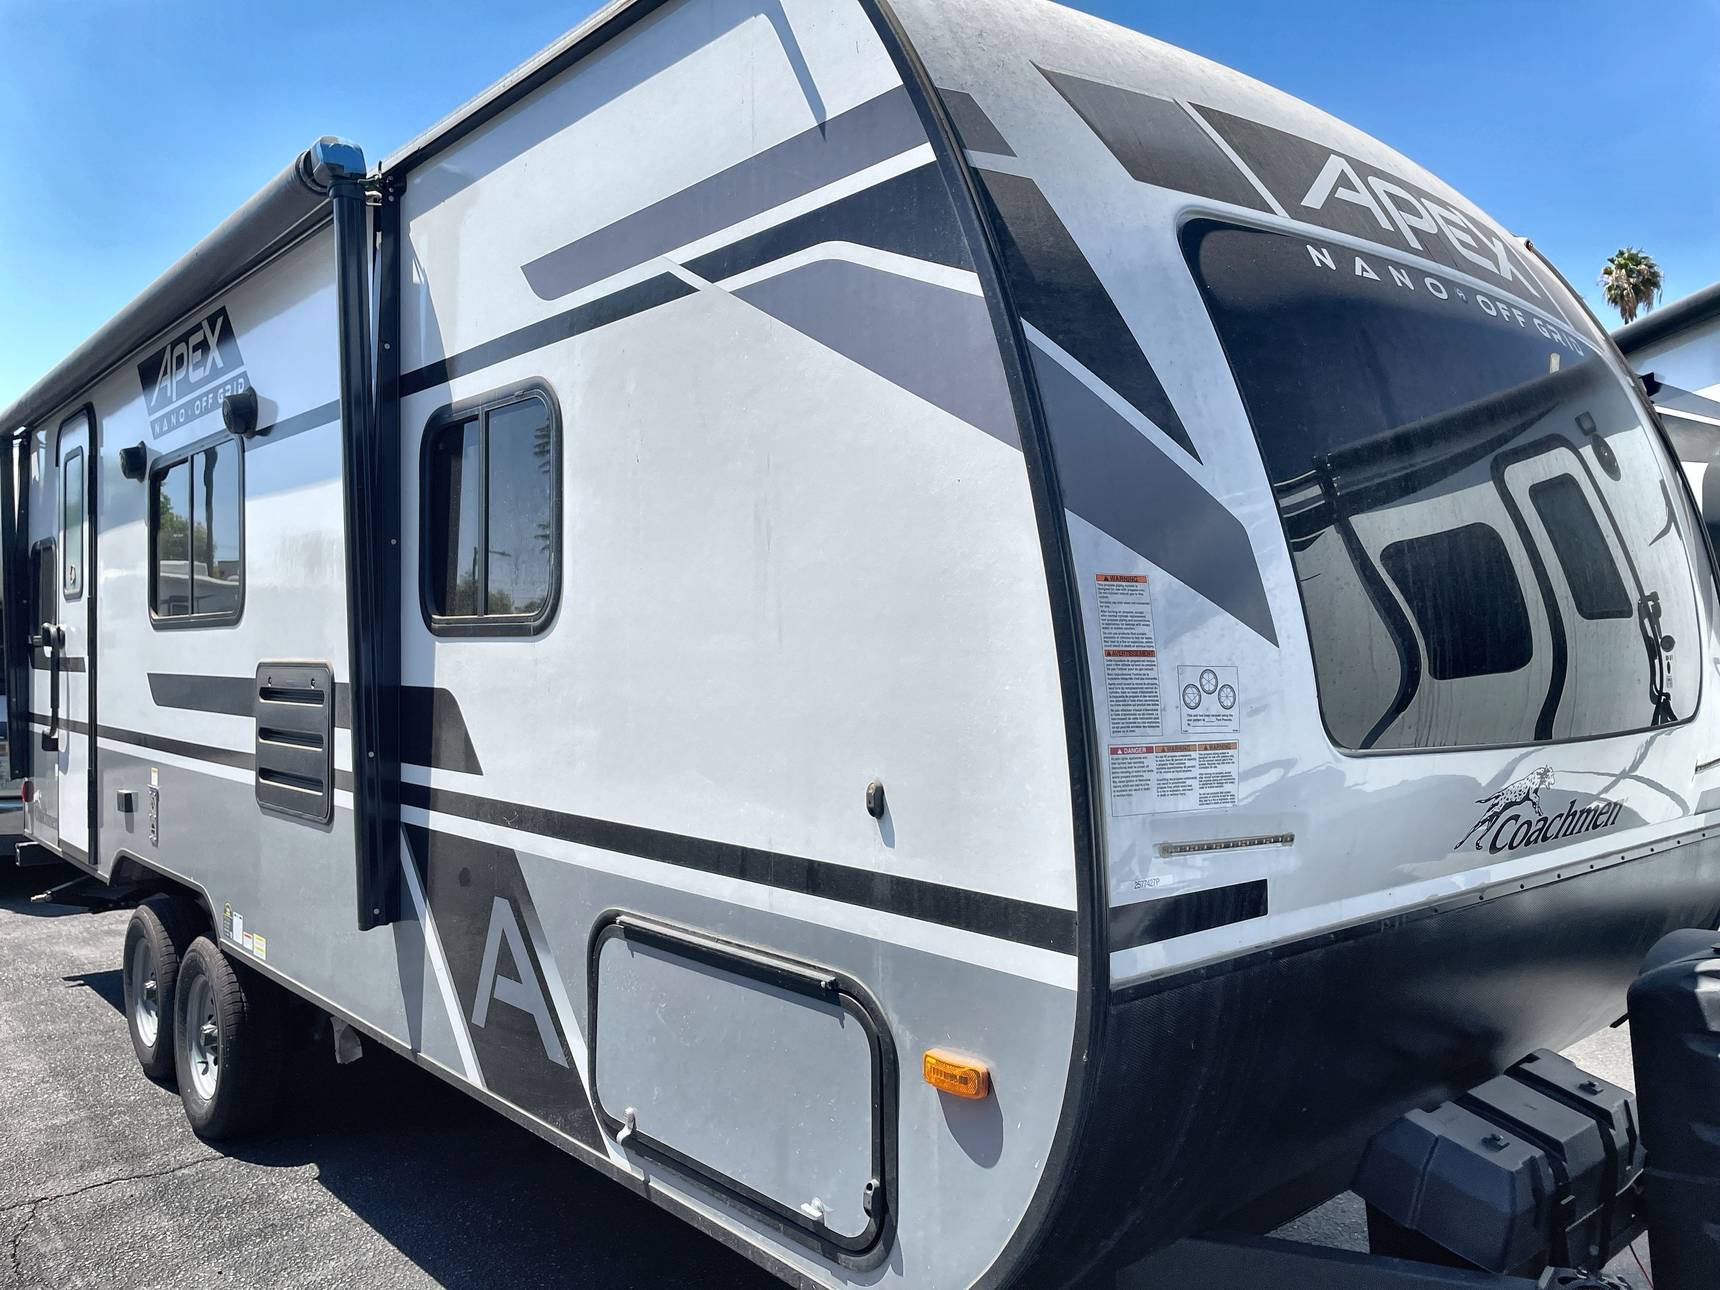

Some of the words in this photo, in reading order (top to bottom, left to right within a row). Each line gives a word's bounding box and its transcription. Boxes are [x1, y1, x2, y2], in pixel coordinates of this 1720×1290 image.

[1300, 153, 1542, 298] APEX
[1305, 244, 1449, 301] NANO
[1475, 293, 1527, 328] OFF
[150, 315, 225, 408] APEX
[153, 408, 186, 435] NANO
[193, 392, 214, 415] OFF
[1123, 746, 1147, 755] DANGER
[1488, 799, 1625, 854] Coachmen
